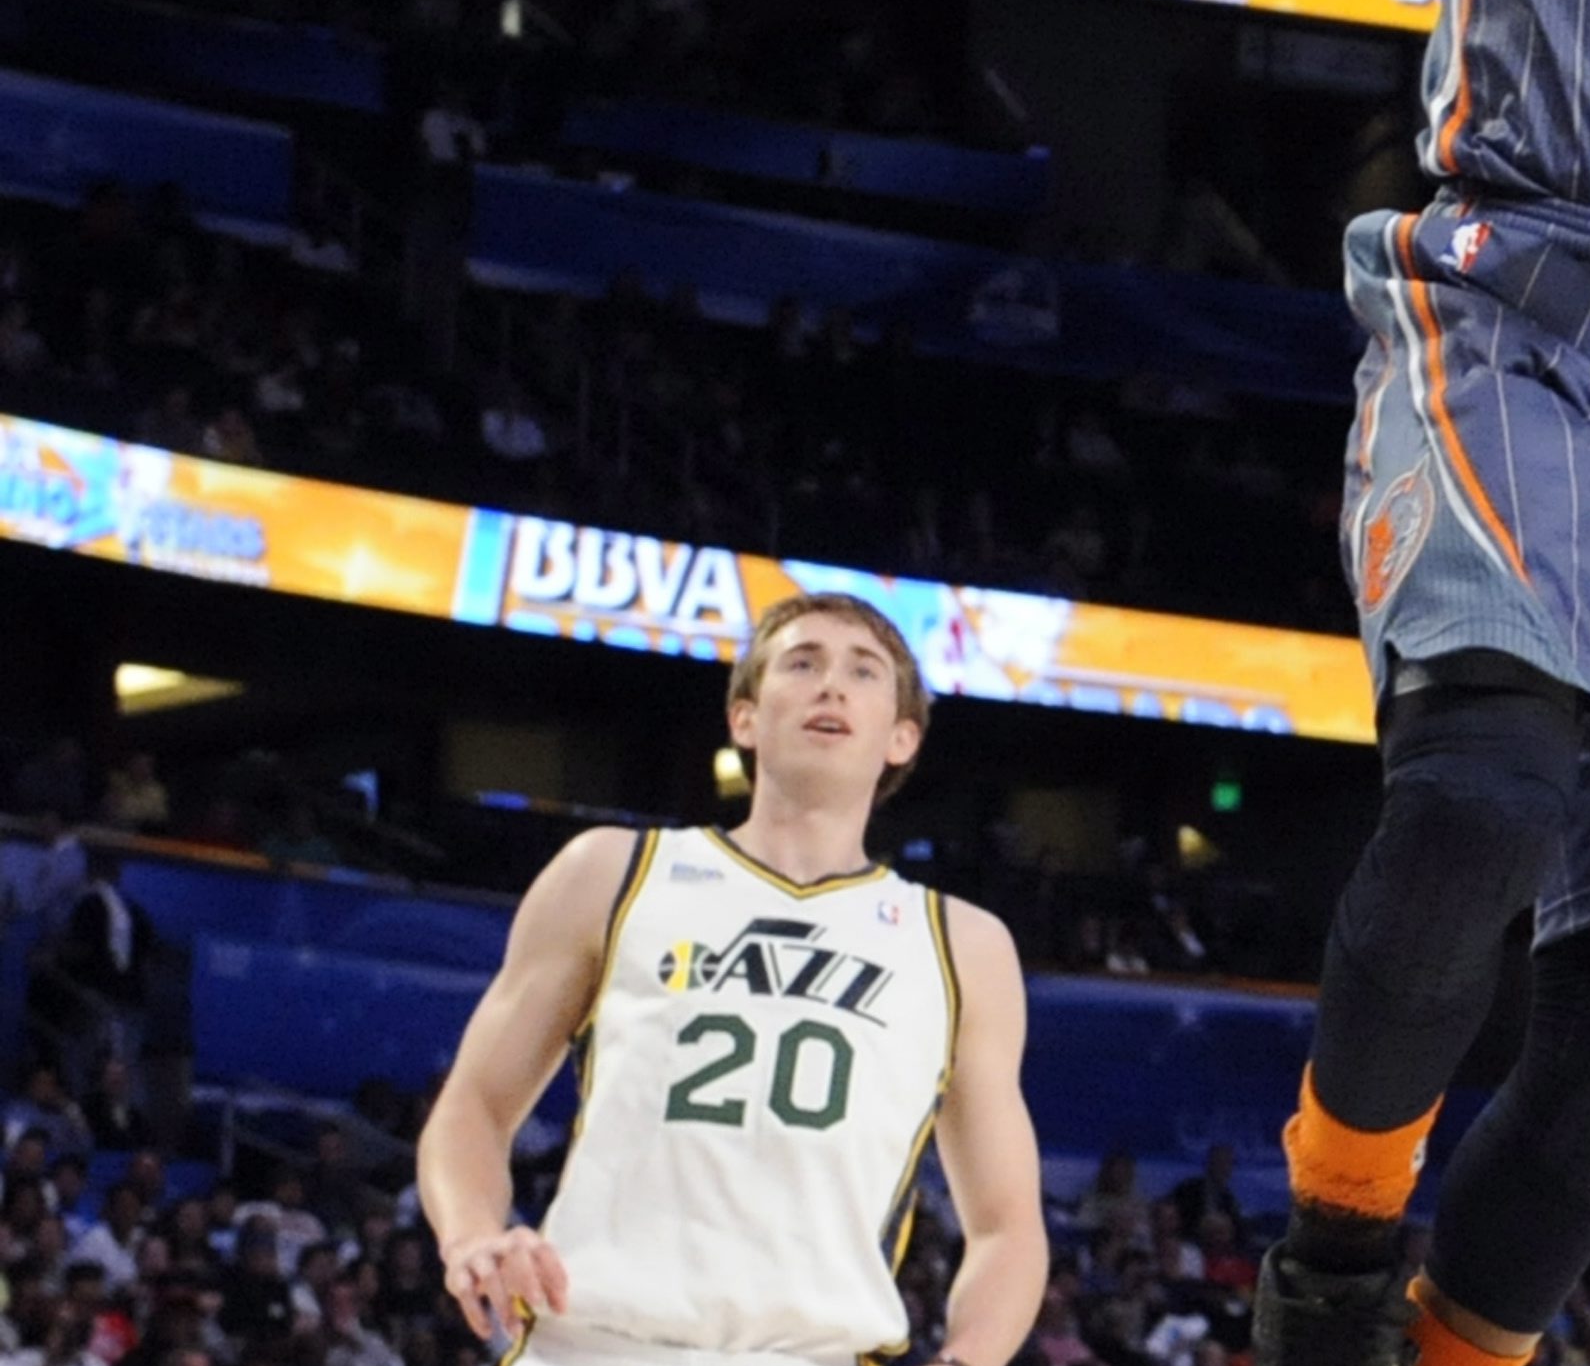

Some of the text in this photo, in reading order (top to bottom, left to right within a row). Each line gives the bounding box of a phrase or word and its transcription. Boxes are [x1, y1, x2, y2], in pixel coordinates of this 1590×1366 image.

[508, 514, 752, 637] BBVA
[658, 917, 894, 1029] JAZZ
[664, 1014, 855, 1131] 20
